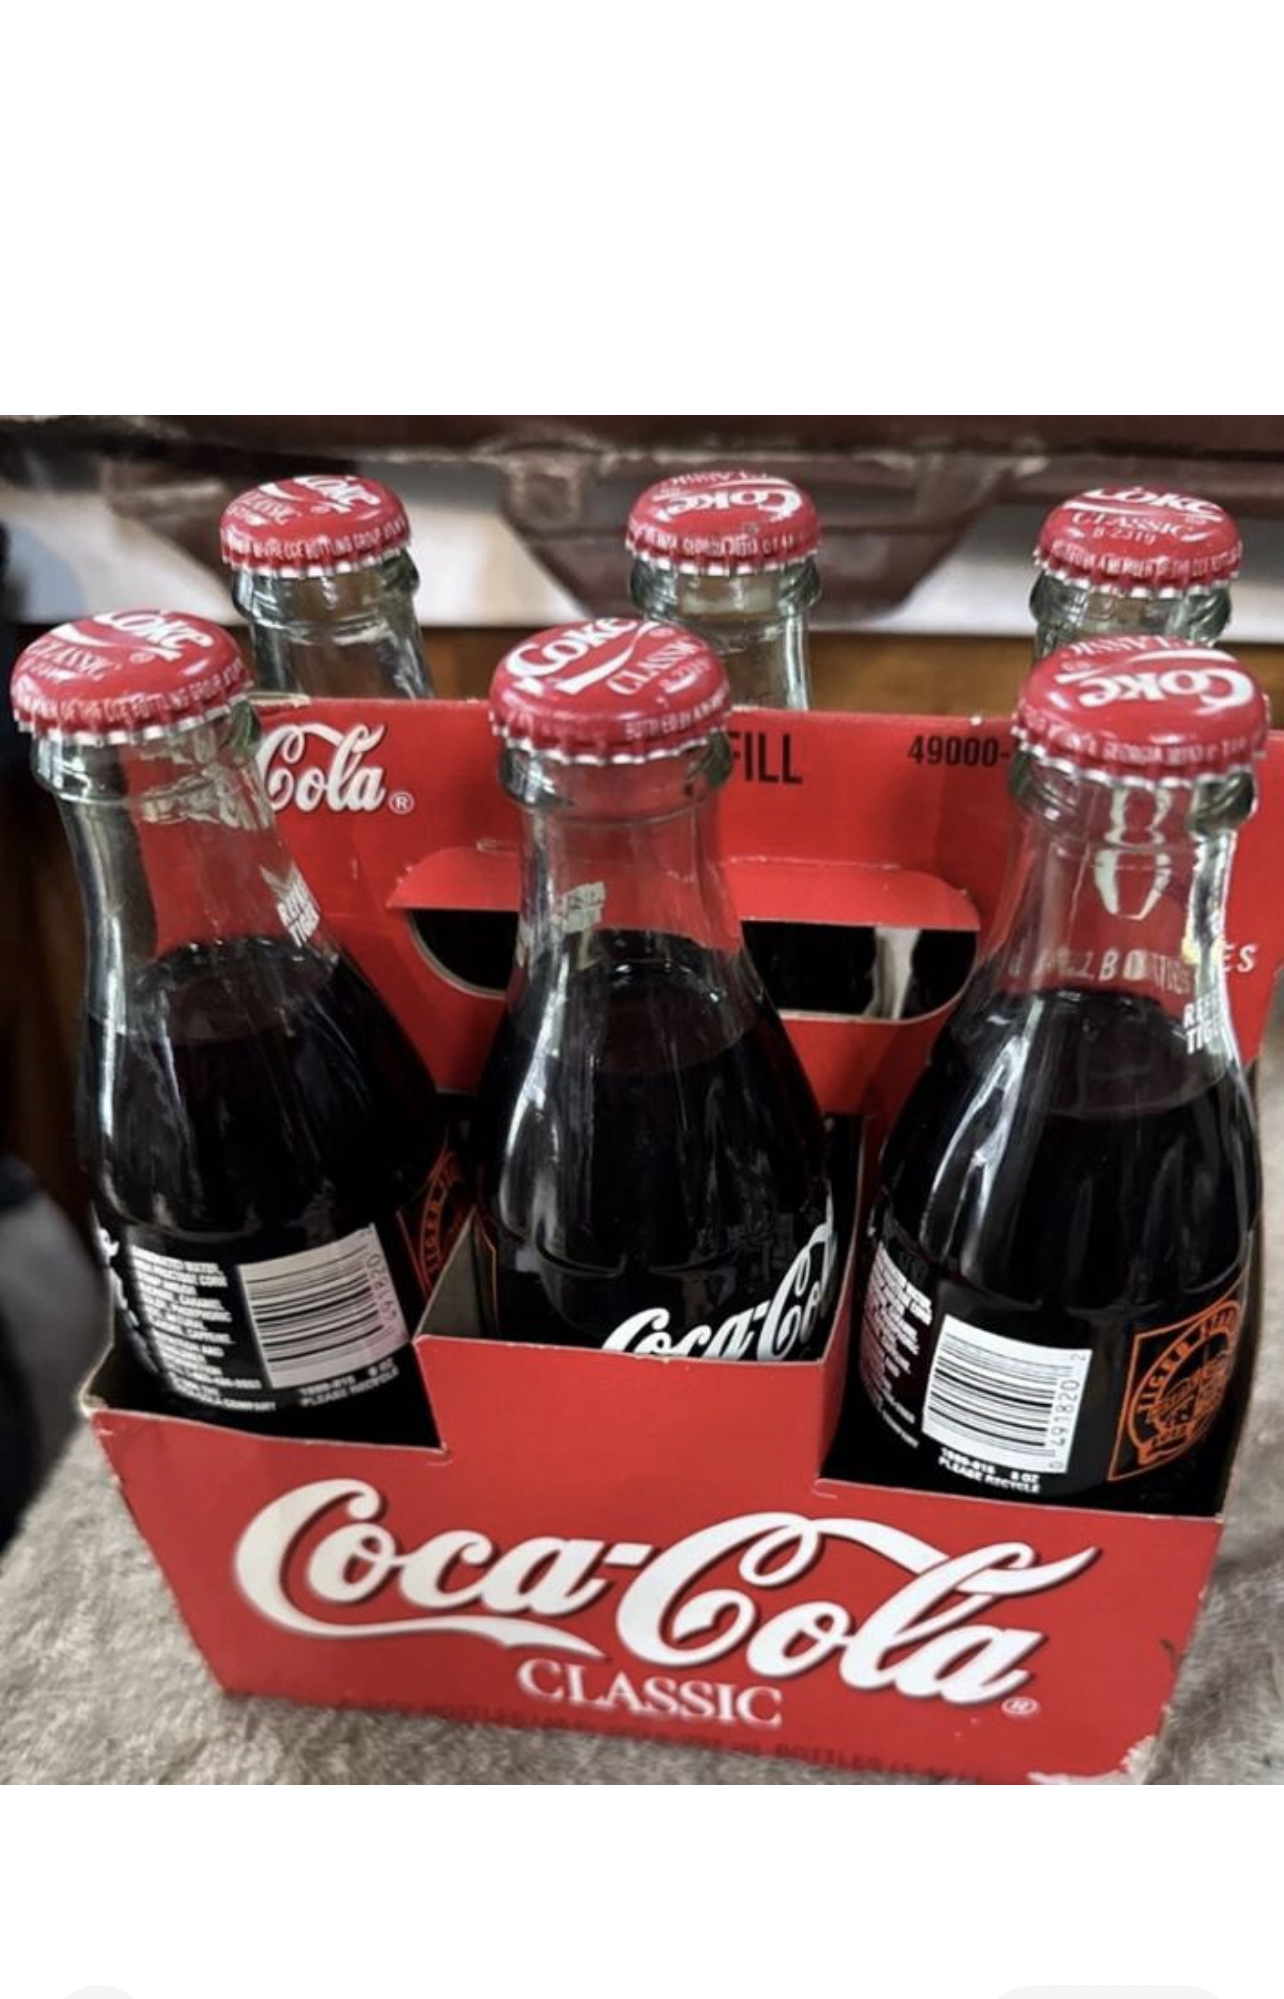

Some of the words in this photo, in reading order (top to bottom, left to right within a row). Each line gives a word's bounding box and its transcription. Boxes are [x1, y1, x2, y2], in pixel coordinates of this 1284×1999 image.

[654, 488, 802, 523] Coke
[1072, 511, 1188, 537] CLASSIC
[505, 618, 638, 677] Coke
[1078, 668, 1255, 715] Coke
[231, 1477, 1103, 1709] Coca-Cola
[516, 1657, 783, 1728] CLASSIC
